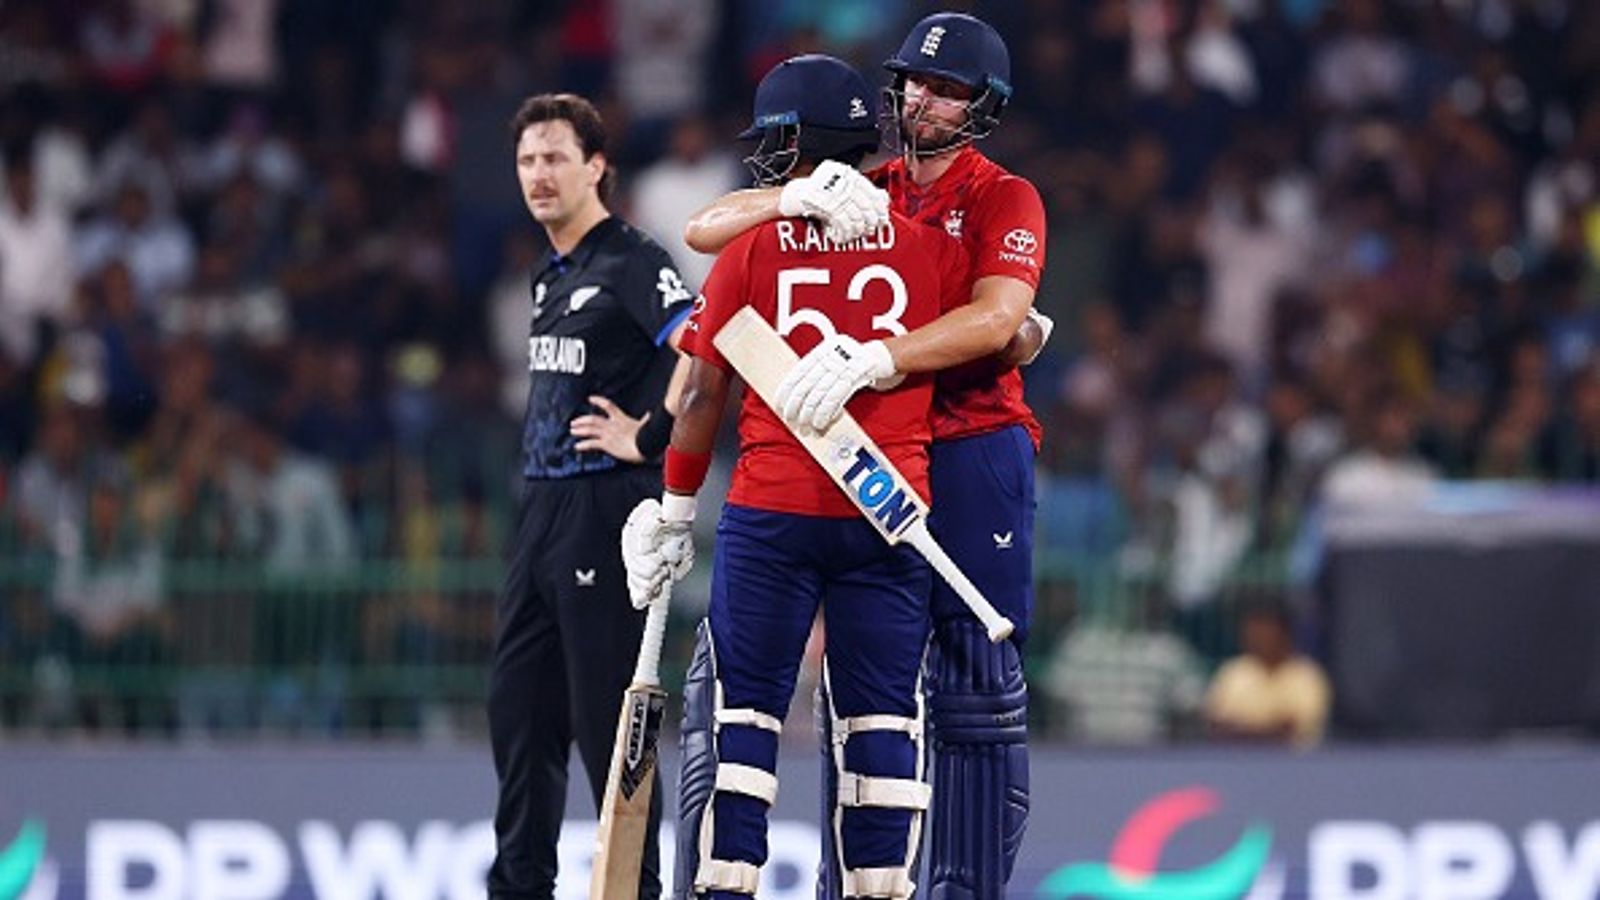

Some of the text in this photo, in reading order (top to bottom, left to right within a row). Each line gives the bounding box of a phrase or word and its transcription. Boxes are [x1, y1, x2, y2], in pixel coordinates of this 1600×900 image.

[776, 221, 896, 252] R.AED
[776, 264, 909, 339] 53
[842, 446, 917, 534] TON
